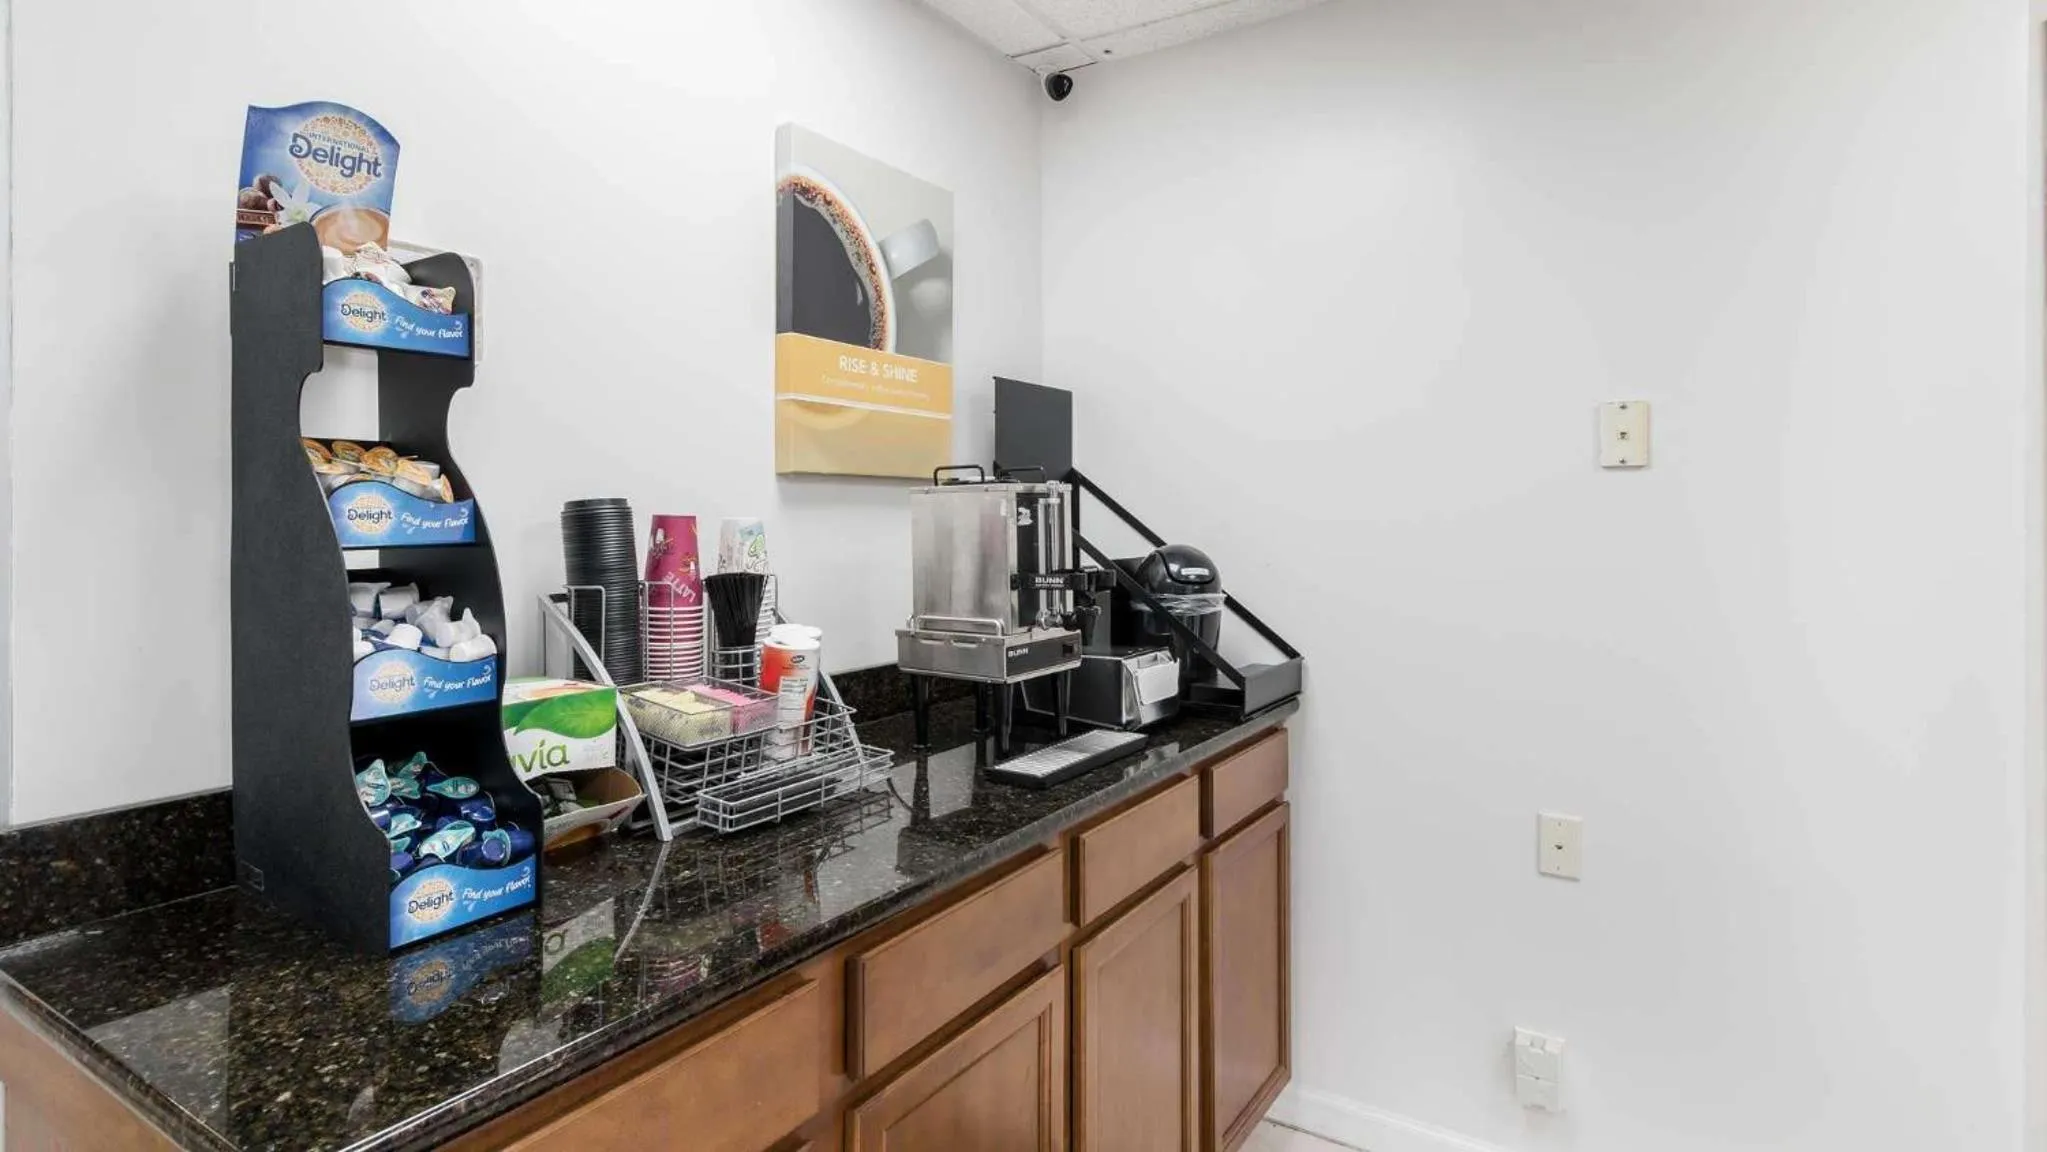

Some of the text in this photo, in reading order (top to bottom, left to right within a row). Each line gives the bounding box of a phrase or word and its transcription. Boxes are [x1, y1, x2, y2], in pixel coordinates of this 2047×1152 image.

[289, 132, 382, 178] Delight
[340, 303, 386, 322] Delight
[395, 315, 414, 331] Find
[839, 355, 919, 383] RISE & SHINE
[347, 508, 393, 524] Delight
[662, 571, 697, 603] LATTE
[1035, 576, 1064, 584] BUNN
[1008, 647, 1029, 658] BUNN
[369, 674, 416, 693] Delight
[407, 891, 455, 914] Delight
